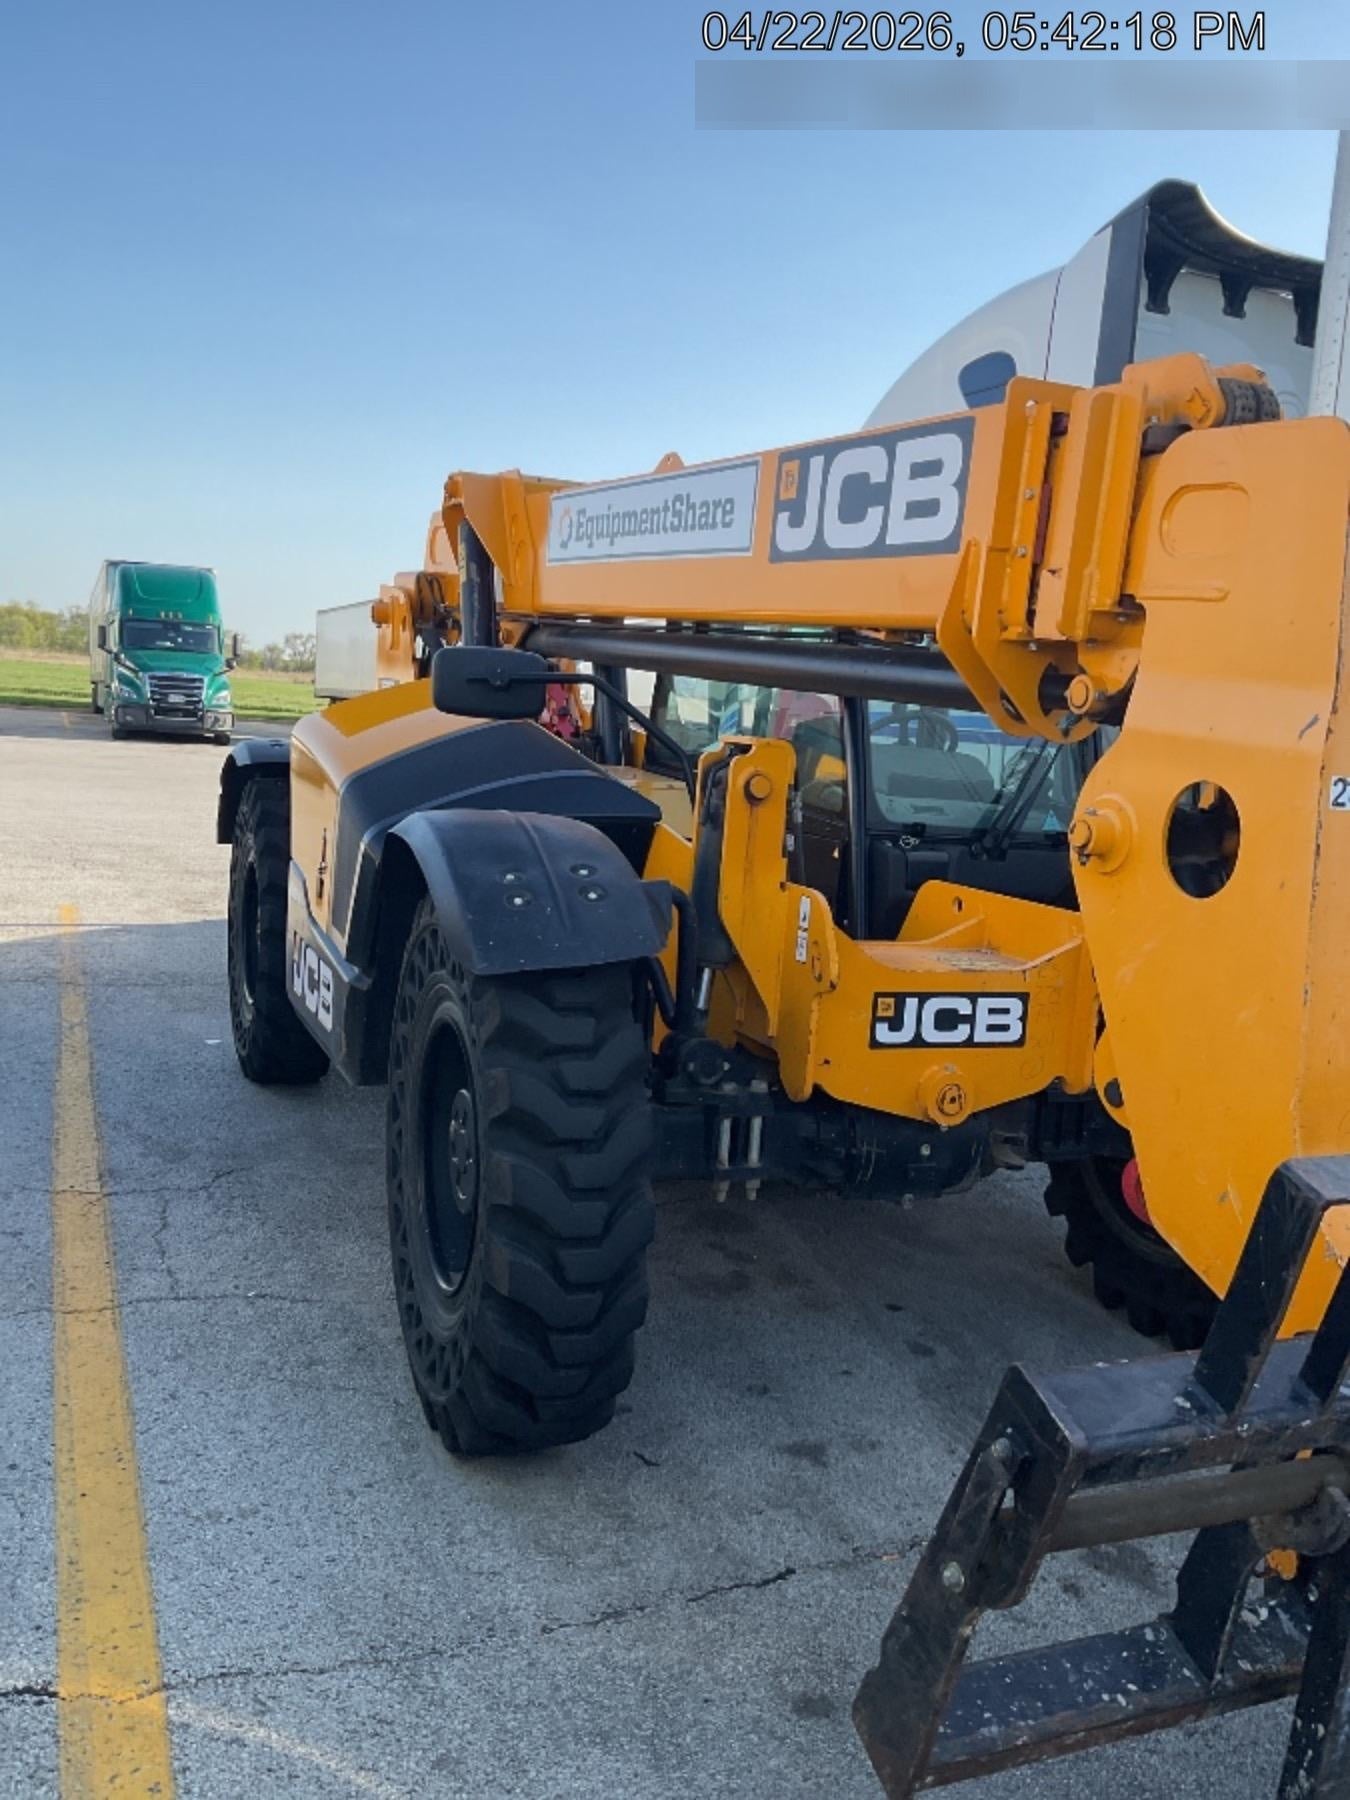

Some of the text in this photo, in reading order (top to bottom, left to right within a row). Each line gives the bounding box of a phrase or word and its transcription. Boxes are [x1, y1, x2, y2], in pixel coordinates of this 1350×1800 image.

[575, 493, 735, 546] EquipmentShare
[776, 433, 963, 553] JCB
[293, 941, 333, 1032] JCB
[875, 997, 1023, 1043] JCB
